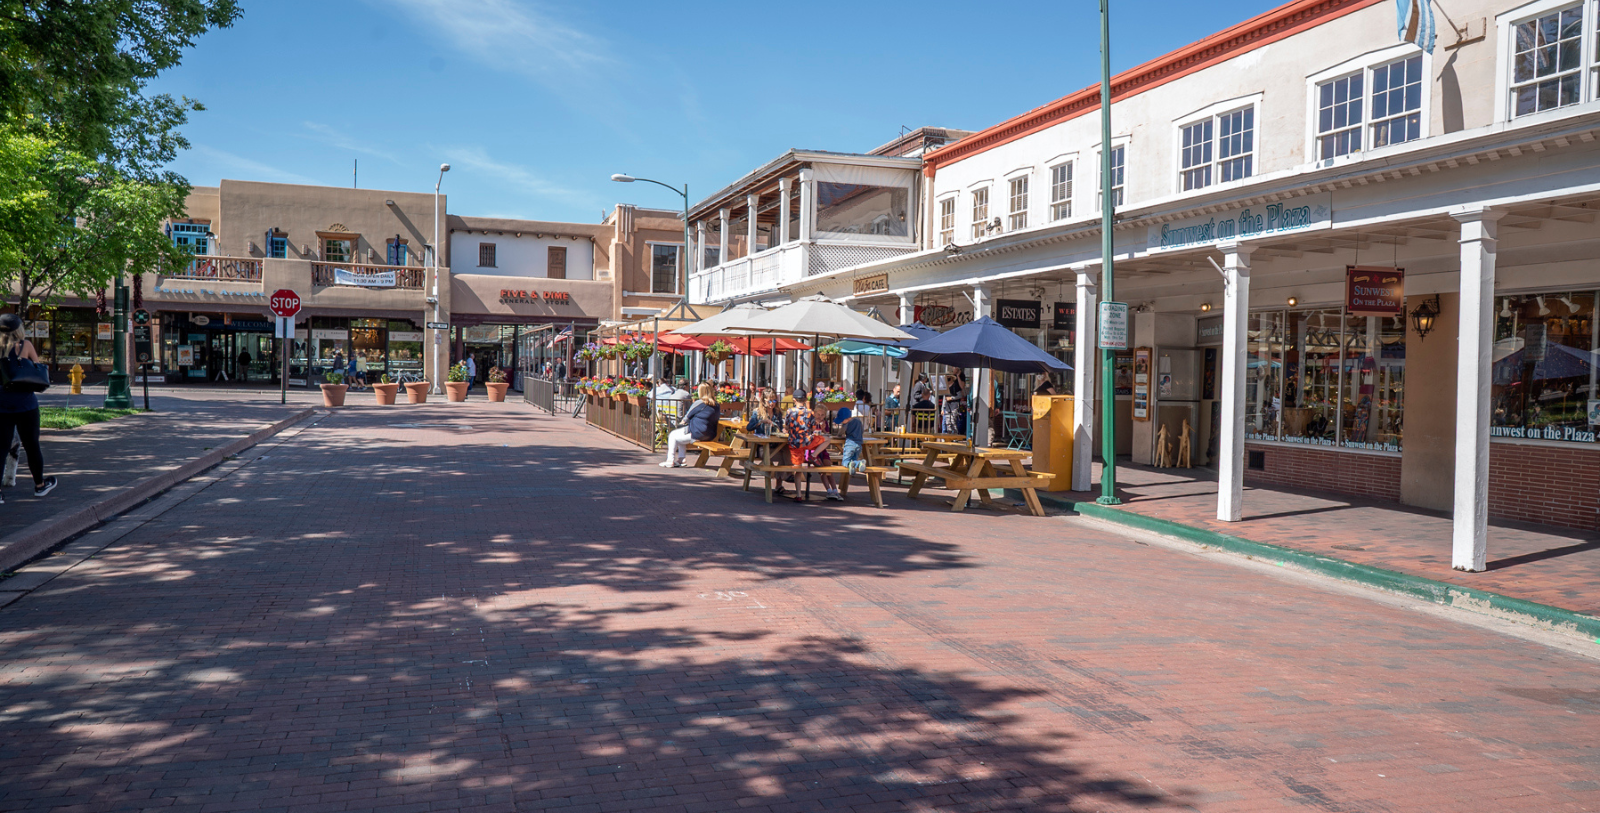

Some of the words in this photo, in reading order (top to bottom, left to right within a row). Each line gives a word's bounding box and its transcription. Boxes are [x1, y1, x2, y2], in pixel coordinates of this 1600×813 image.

[1161, 217, 1215, 250] Sunwest
[1217, 218, 1235, 241] on
[1238, 209, 1263, 237] the
[1266, 203, 1311, 233] Plaza
[872, 279, 884, 290] CAFE
[154, 286, 194, 294] Santa
[220, 289, 265, 297] Arcade
[501, 289, 526, 298] FIVE
[531, 290, 538, 298] &
[543, 291, 569, 300] DIME
[1354, 285, 1395, 297] SUNWEST
[272, 297, 299, 309] STOP
[1002, 306, 1036, 320] ESTATES
[231, 320, 272, 328] WELCOME
[1262, 432, 1275, 441] Plaza
[1490, 425, 1525, 438] unwest
[1527, 428, 1540, 438] on
[1543, 426, 1561, 440] the
[1563, 427, 1595, 442] Plaza
[1285, 434, 1303, 443] Sunwest
[1304, 436, 1310, 444] on
[1310, 435, 1318, 445] the
[1318, 436, 1332, 446] Plaza
[1345, 439, 1366, 449] Sunwest
[1366, 442, 1373, 450] on
[1374, 441, 1383, 451] the
[1383, 442, 1398, 452] Plaza
